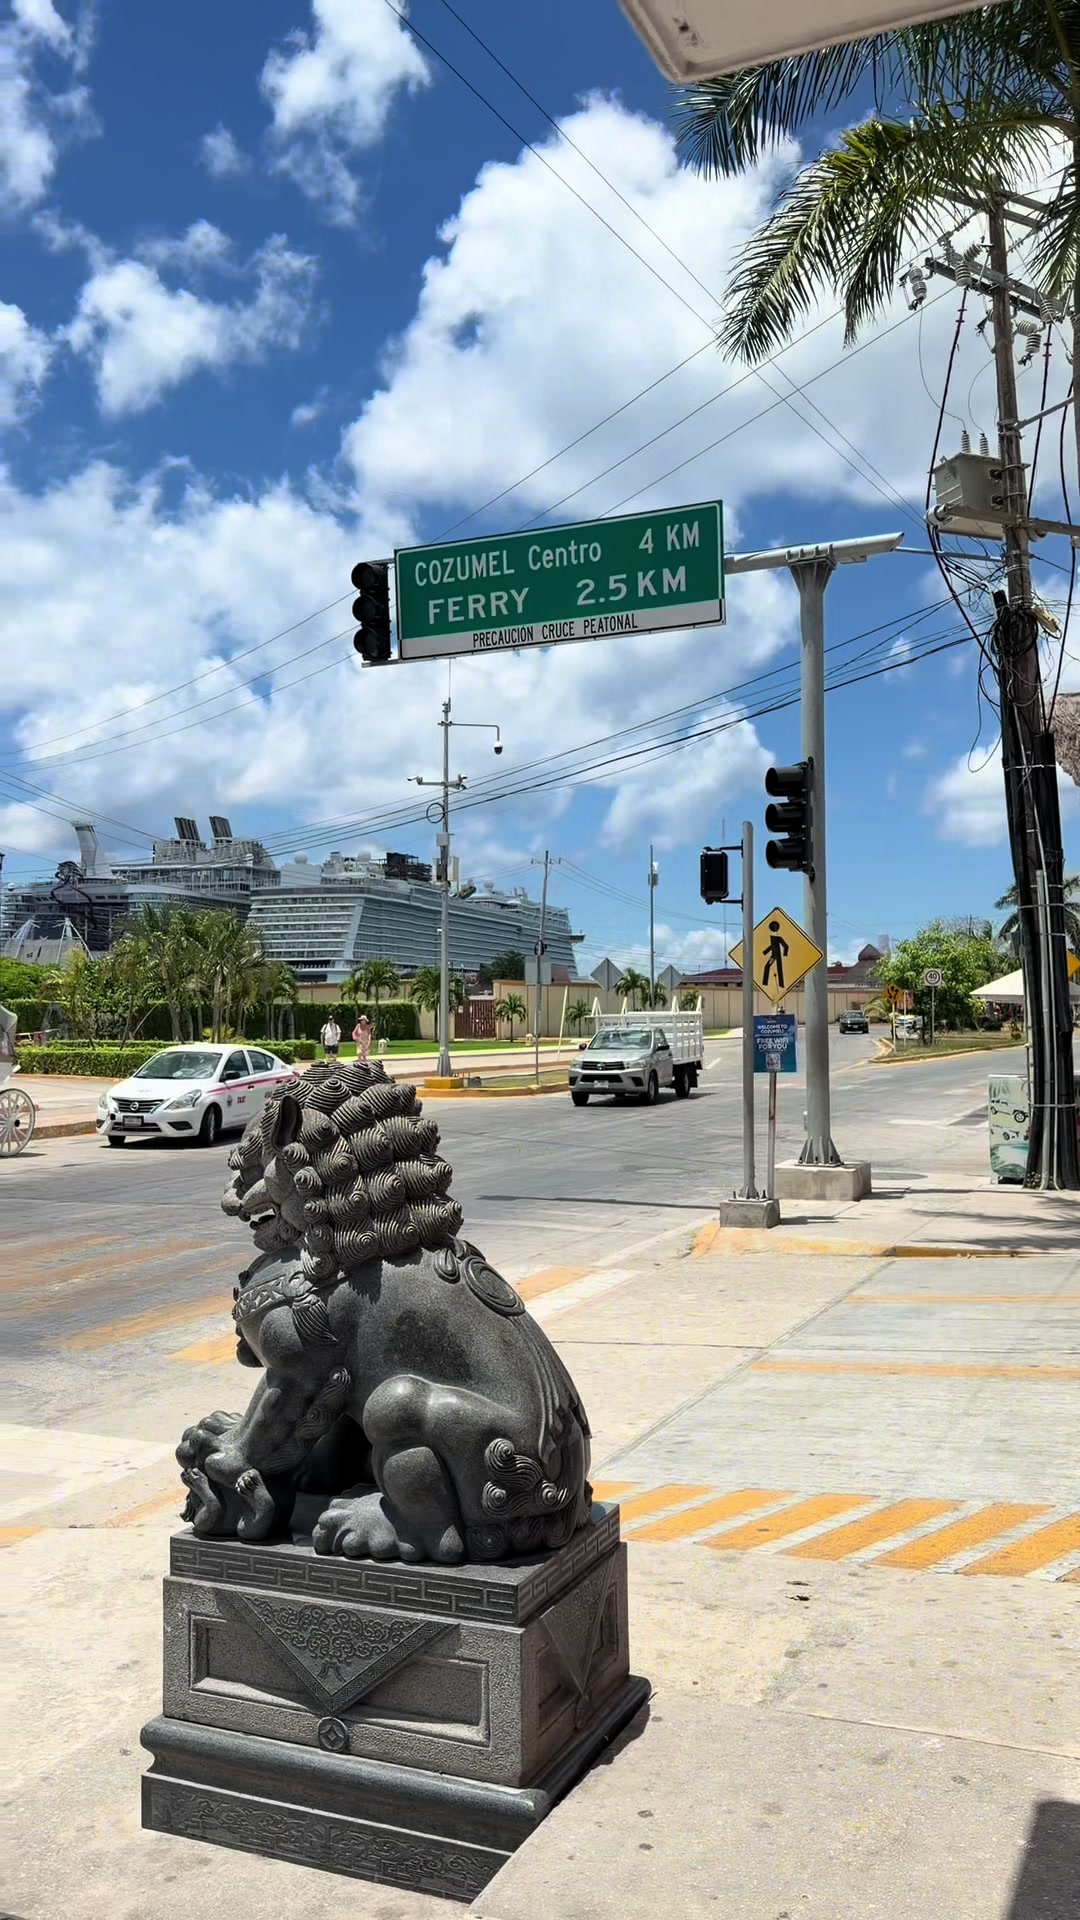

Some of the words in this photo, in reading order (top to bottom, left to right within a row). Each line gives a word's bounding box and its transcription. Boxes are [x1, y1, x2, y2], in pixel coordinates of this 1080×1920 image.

[415, 550, 515, 587] COZUMEL
[528, 540, 602, 571] Centro
[638, 528, 654, 555] 4
[666, 521, 700, 552] KM
[428, 587, 529, 625] FERRY
[576, 573, 628, 606] 2.5
[637, 565, 686, 598] KM
[541, 621, 575, 640] CRUCE
[583, 613, 639, 635] PEATONAL
